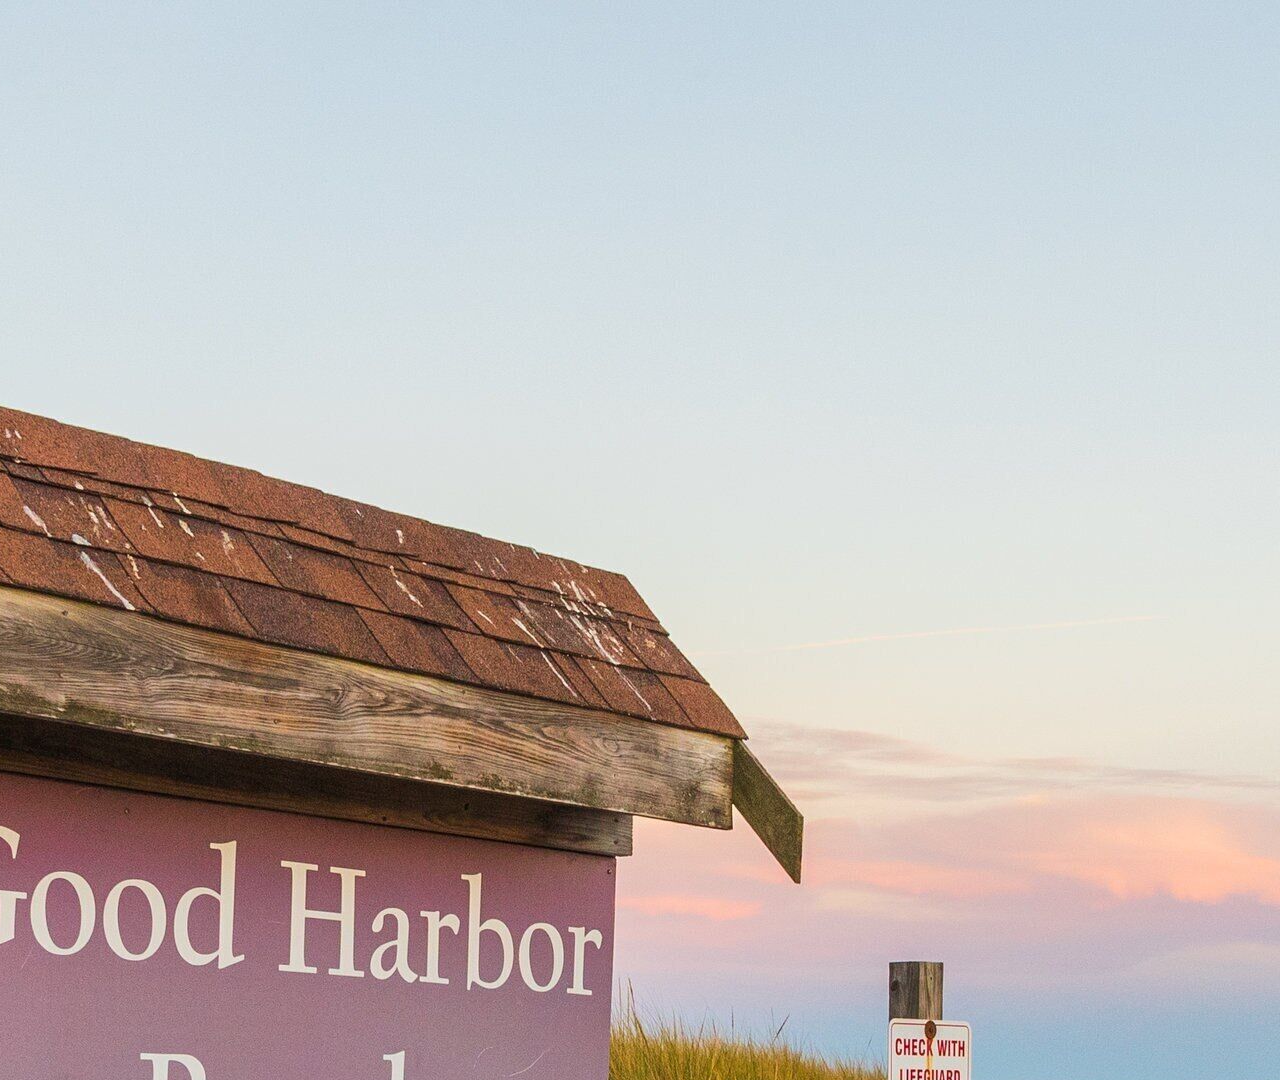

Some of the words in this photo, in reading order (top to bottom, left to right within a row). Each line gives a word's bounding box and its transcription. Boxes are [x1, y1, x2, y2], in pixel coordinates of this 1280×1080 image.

[278, 860, 603, 996] Harbor
[895, 1038, 933, 1057] CHECK
[937, 1039, 965, 1057] WITH
